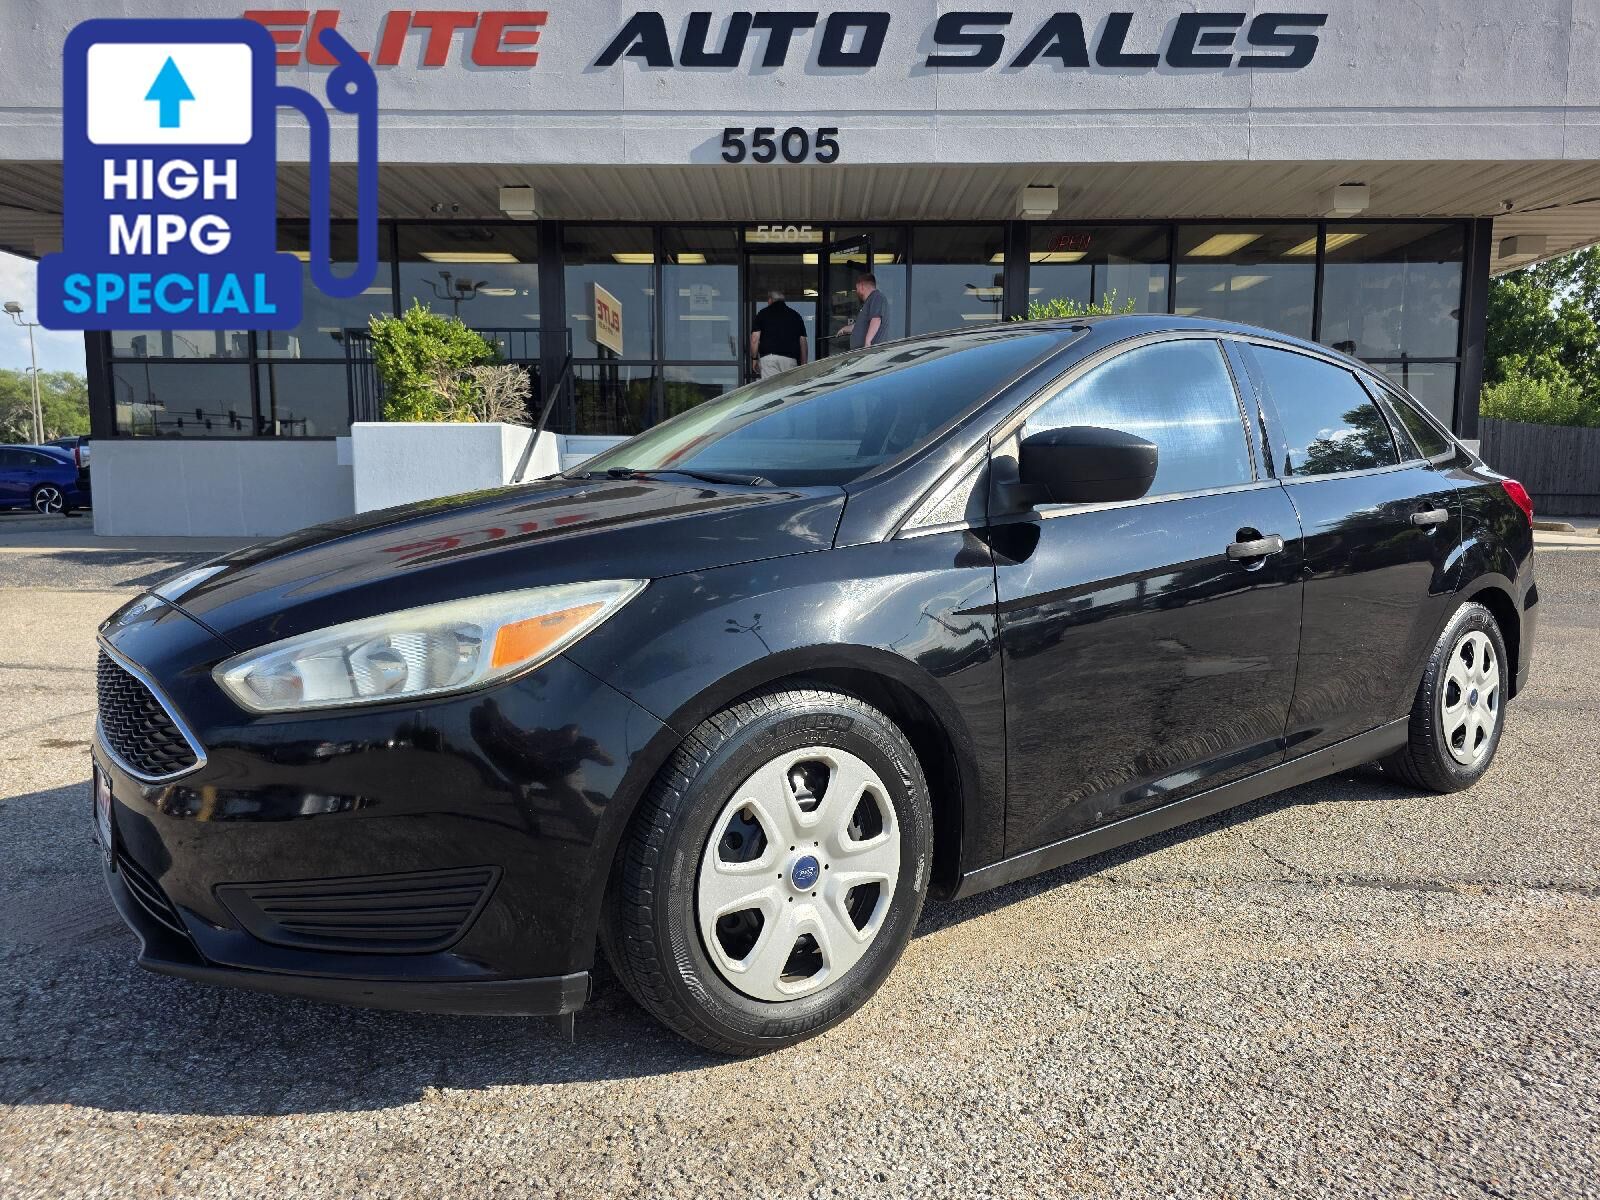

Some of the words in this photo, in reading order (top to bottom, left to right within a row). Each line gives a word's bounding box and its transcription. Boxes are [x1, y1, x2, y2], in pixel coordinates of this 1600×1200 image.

[243, 10, 548, 66] ELITE
[594, 12, 891, 67] AUTO
[925, 12, 1328, 68] SALES
[721, 127, 840, 164] 5505
[756, 225, 813, 243] 5505
[1048, 233, 1091, 253] OPEN
